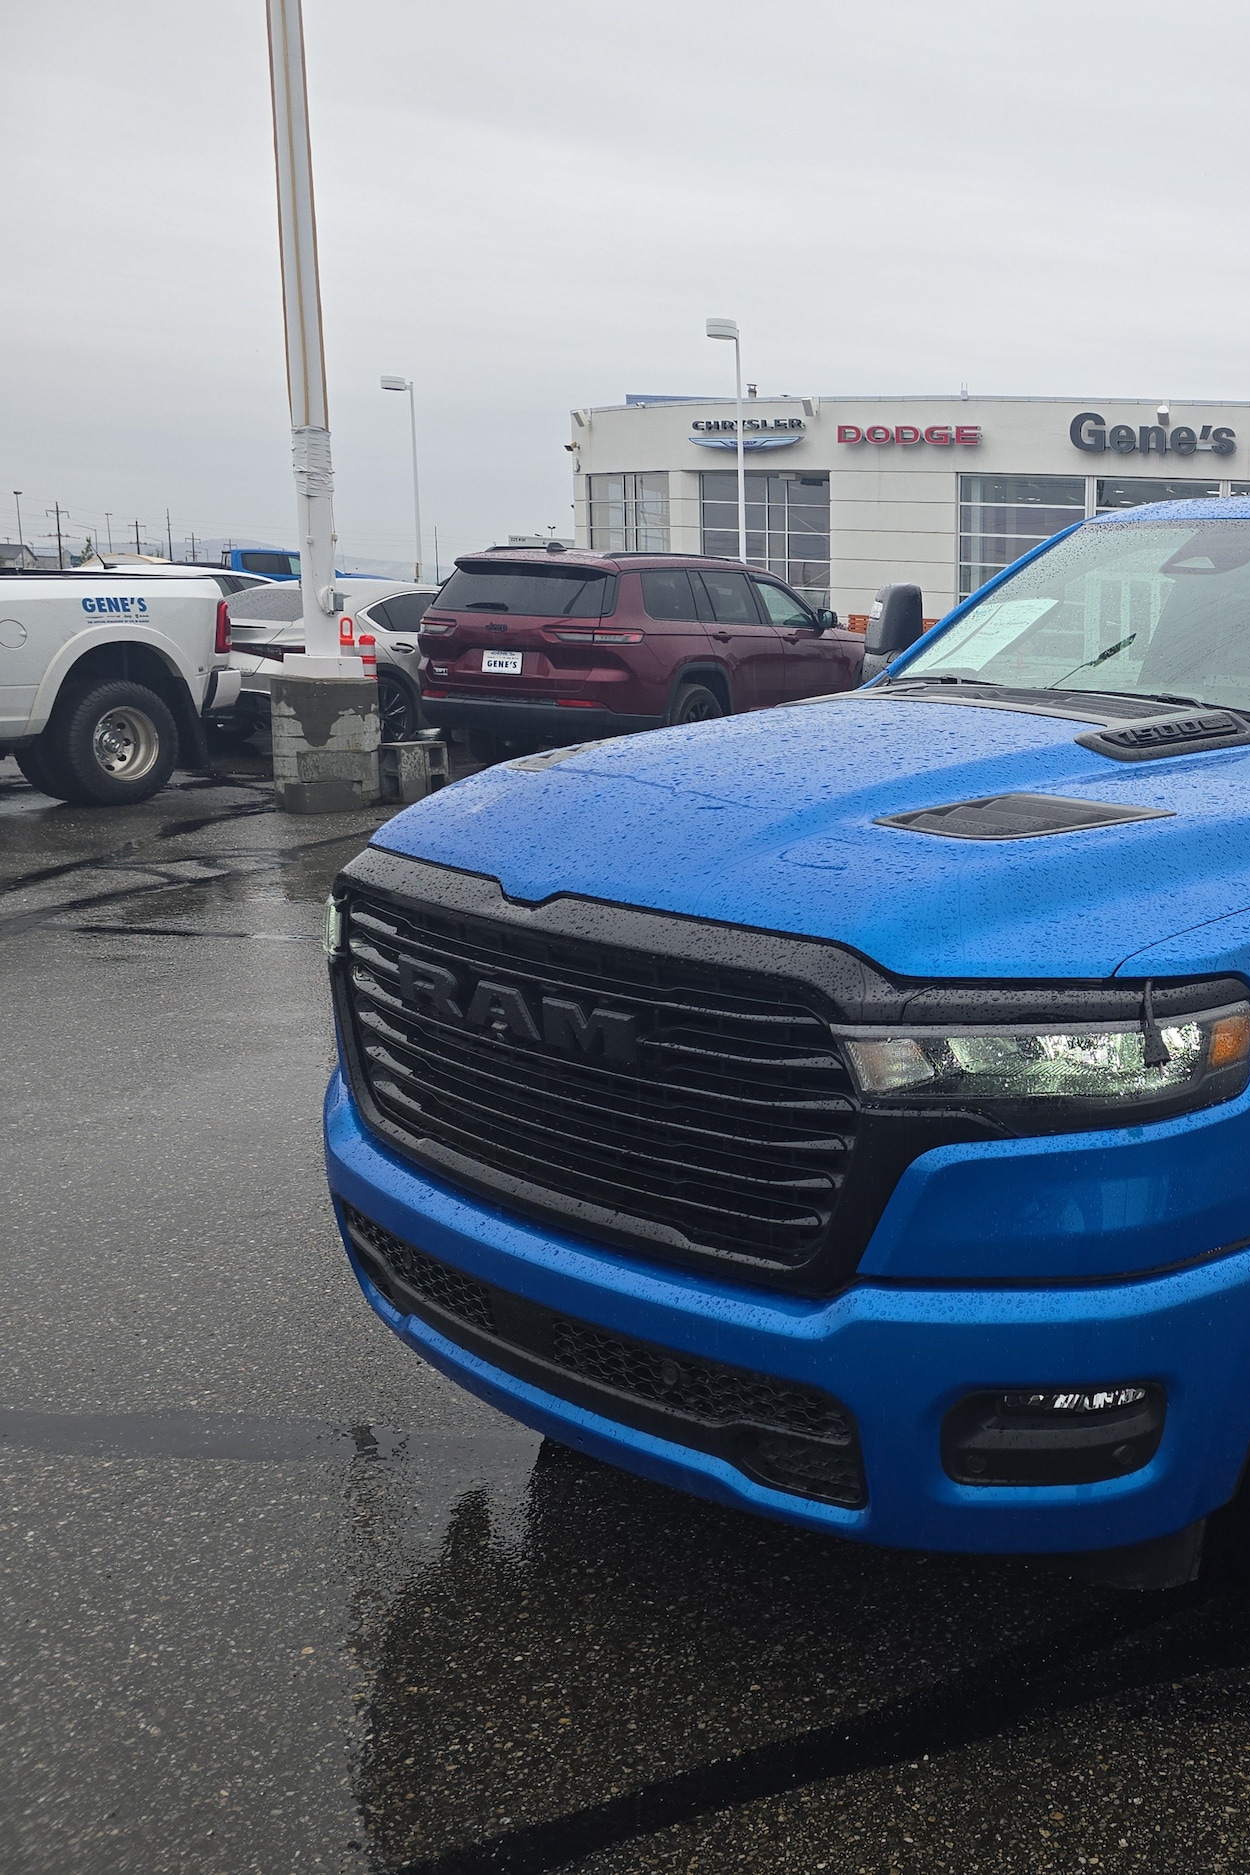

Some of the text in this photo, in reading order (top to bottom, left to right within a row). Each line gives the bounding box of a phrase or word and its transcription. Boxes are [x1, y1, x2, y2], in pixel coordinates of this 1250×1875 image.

[837, 425, 982, 445] DODGE
[1069, 411, 1237, 457] Gene's
[81, 597, 148, 613] GENE'S
[487, 660, 517, 669] GENE'S
[399, 954, 636, 1058] RAM
